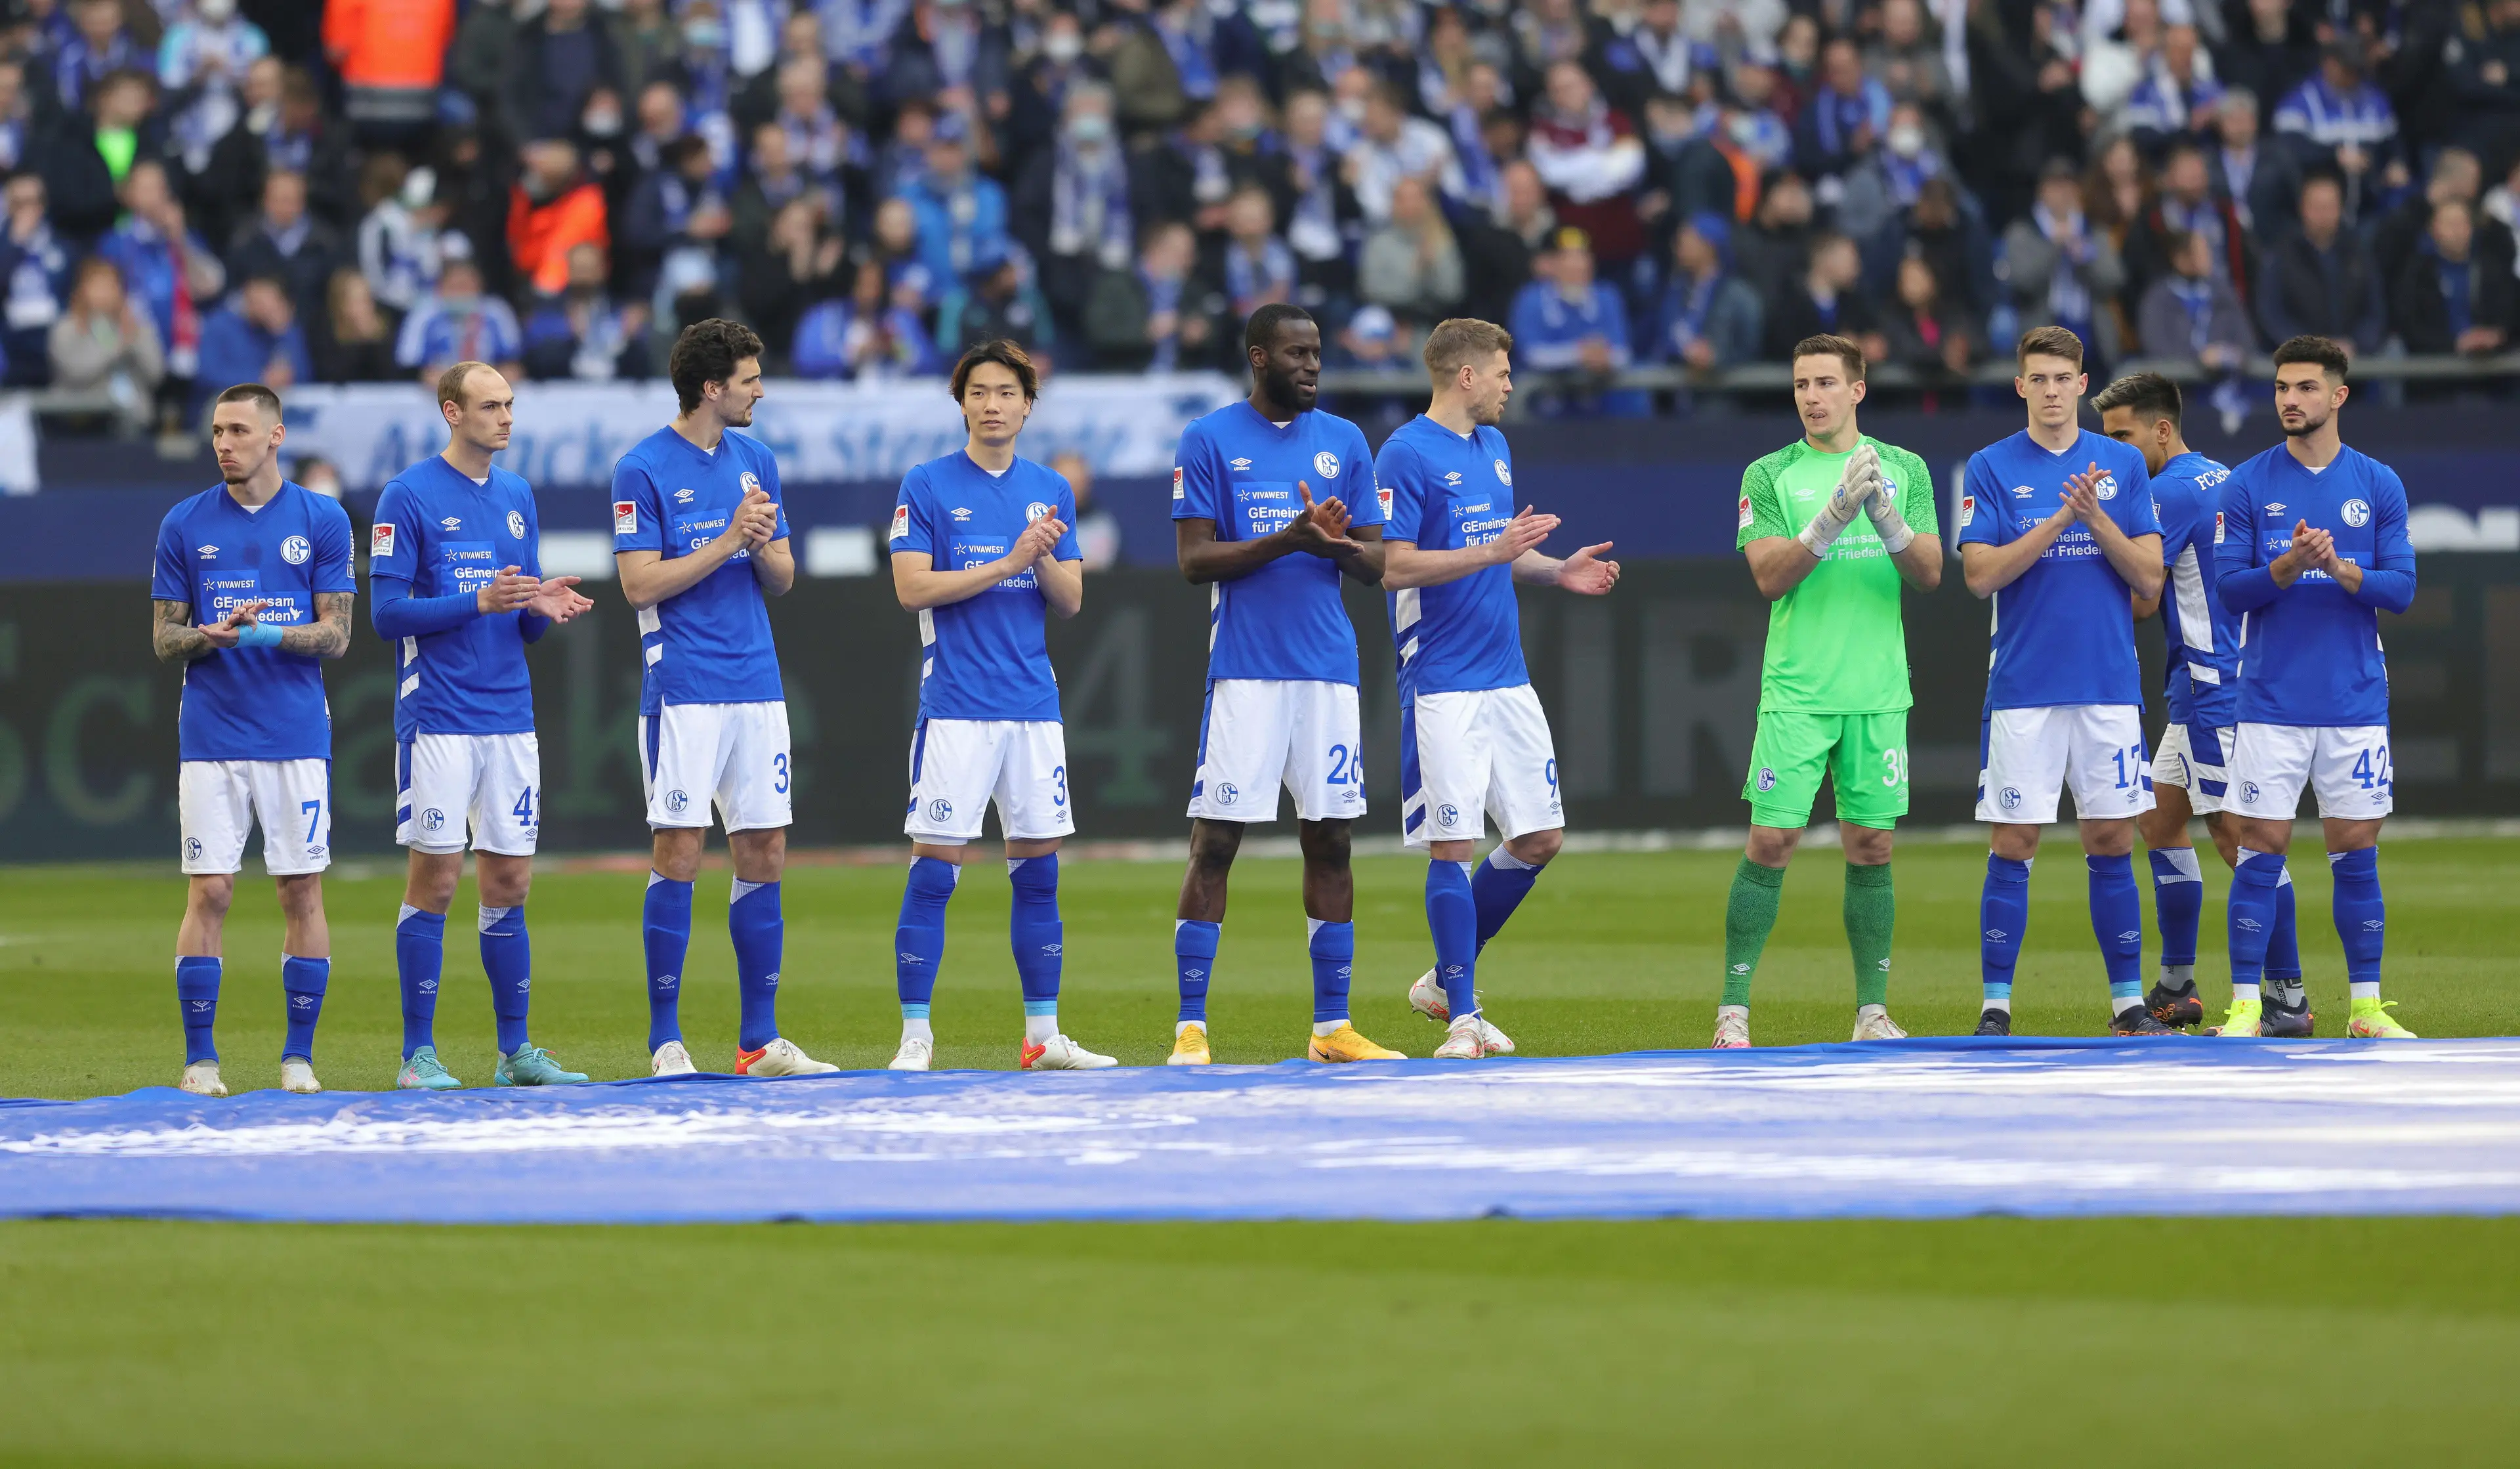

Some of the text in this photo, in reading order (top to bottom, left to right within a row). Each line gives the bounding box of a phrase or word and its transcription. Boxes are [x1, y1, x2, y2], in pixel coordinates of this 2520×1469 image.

[2194, 471, 2215, 490] FC
[1465, 503, 1490, 513] VIVAWEST
[694, 519, 725, 530] VIVAWEST
[1252, 521, 1271, 533] für
[1465, 535, 1480, 547] für
[969, 545, 1004, 554] VIVAWEST
[1838, 547, 1883, 560] Frieden
[459, 582, 478, 593] für
[998, 577, 1033, 589] ieden
[253, 610, 291, 622] eden
[1327, 743, 1359, 784] 26
[1882, 745, 1908, 787] 30
[2112, 743, 2140, 789] 17
[2352, 745, 2388, 790] 42
[1545, 758, 1557, 798] 9
[1053, 765, 1066, 806] 3
[301, 799, 320, 843] 7
